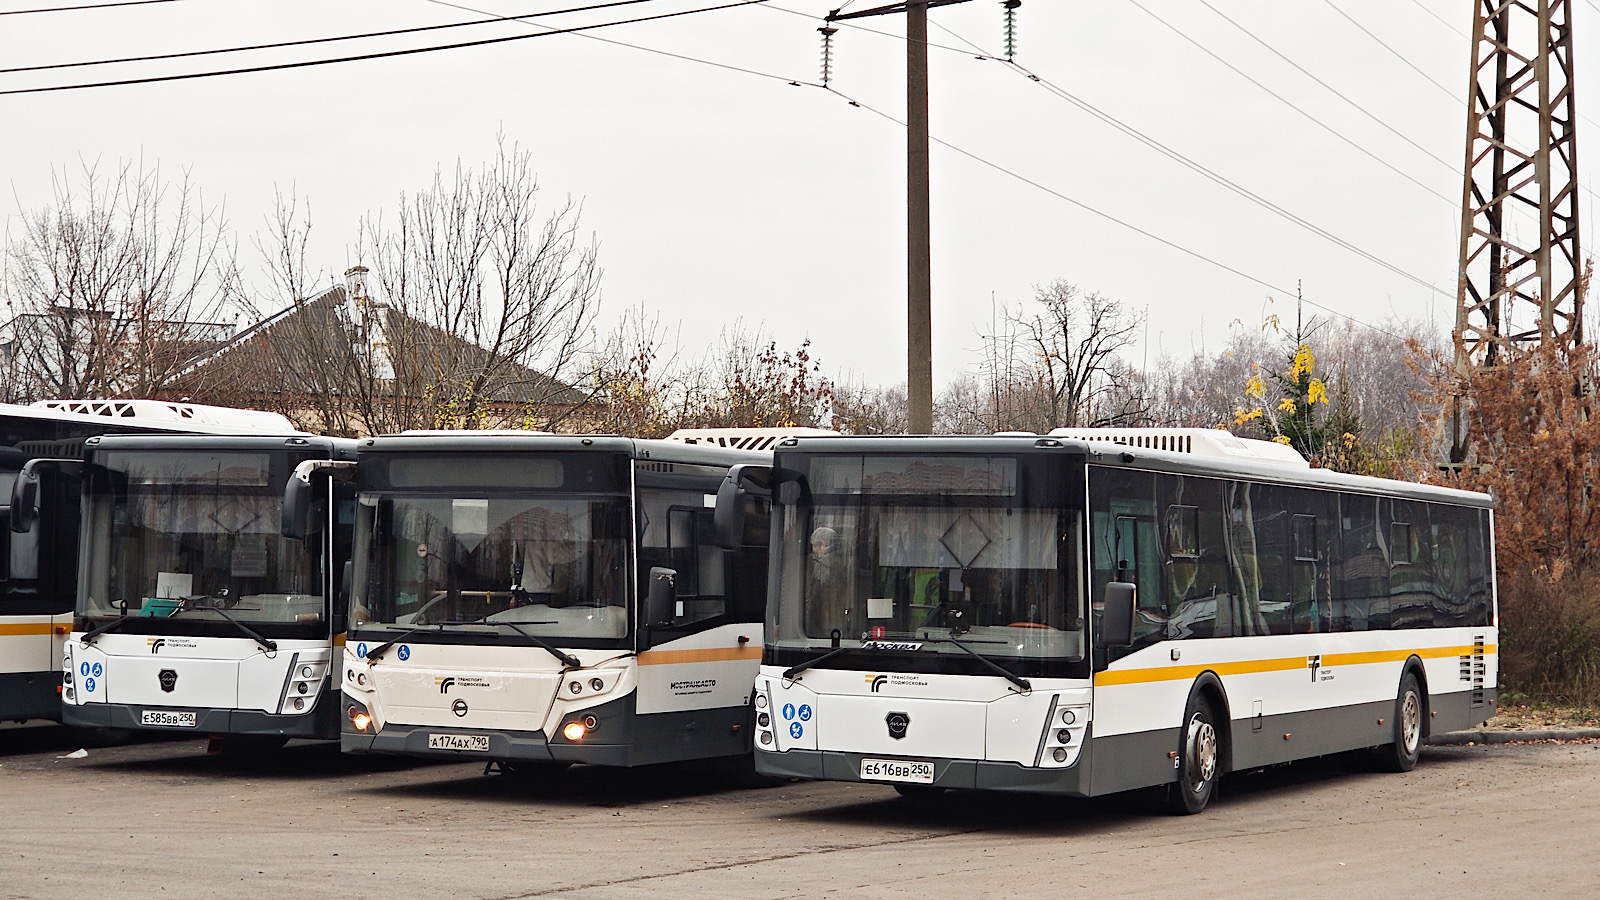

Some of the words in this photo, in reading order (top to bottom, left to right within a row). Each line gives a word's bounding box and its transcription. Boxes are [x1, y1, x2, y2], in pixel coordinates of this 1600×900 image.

[144, 712, 178, 725] Е585ВВ
[179, 713, 194, 722] 250
[432, 736, 470, 749] А174АХ
[471, 736, 487, 746] 790
[866, 762, 910, 777] Е616ВВ
[911, 764, 929, 775] 250
